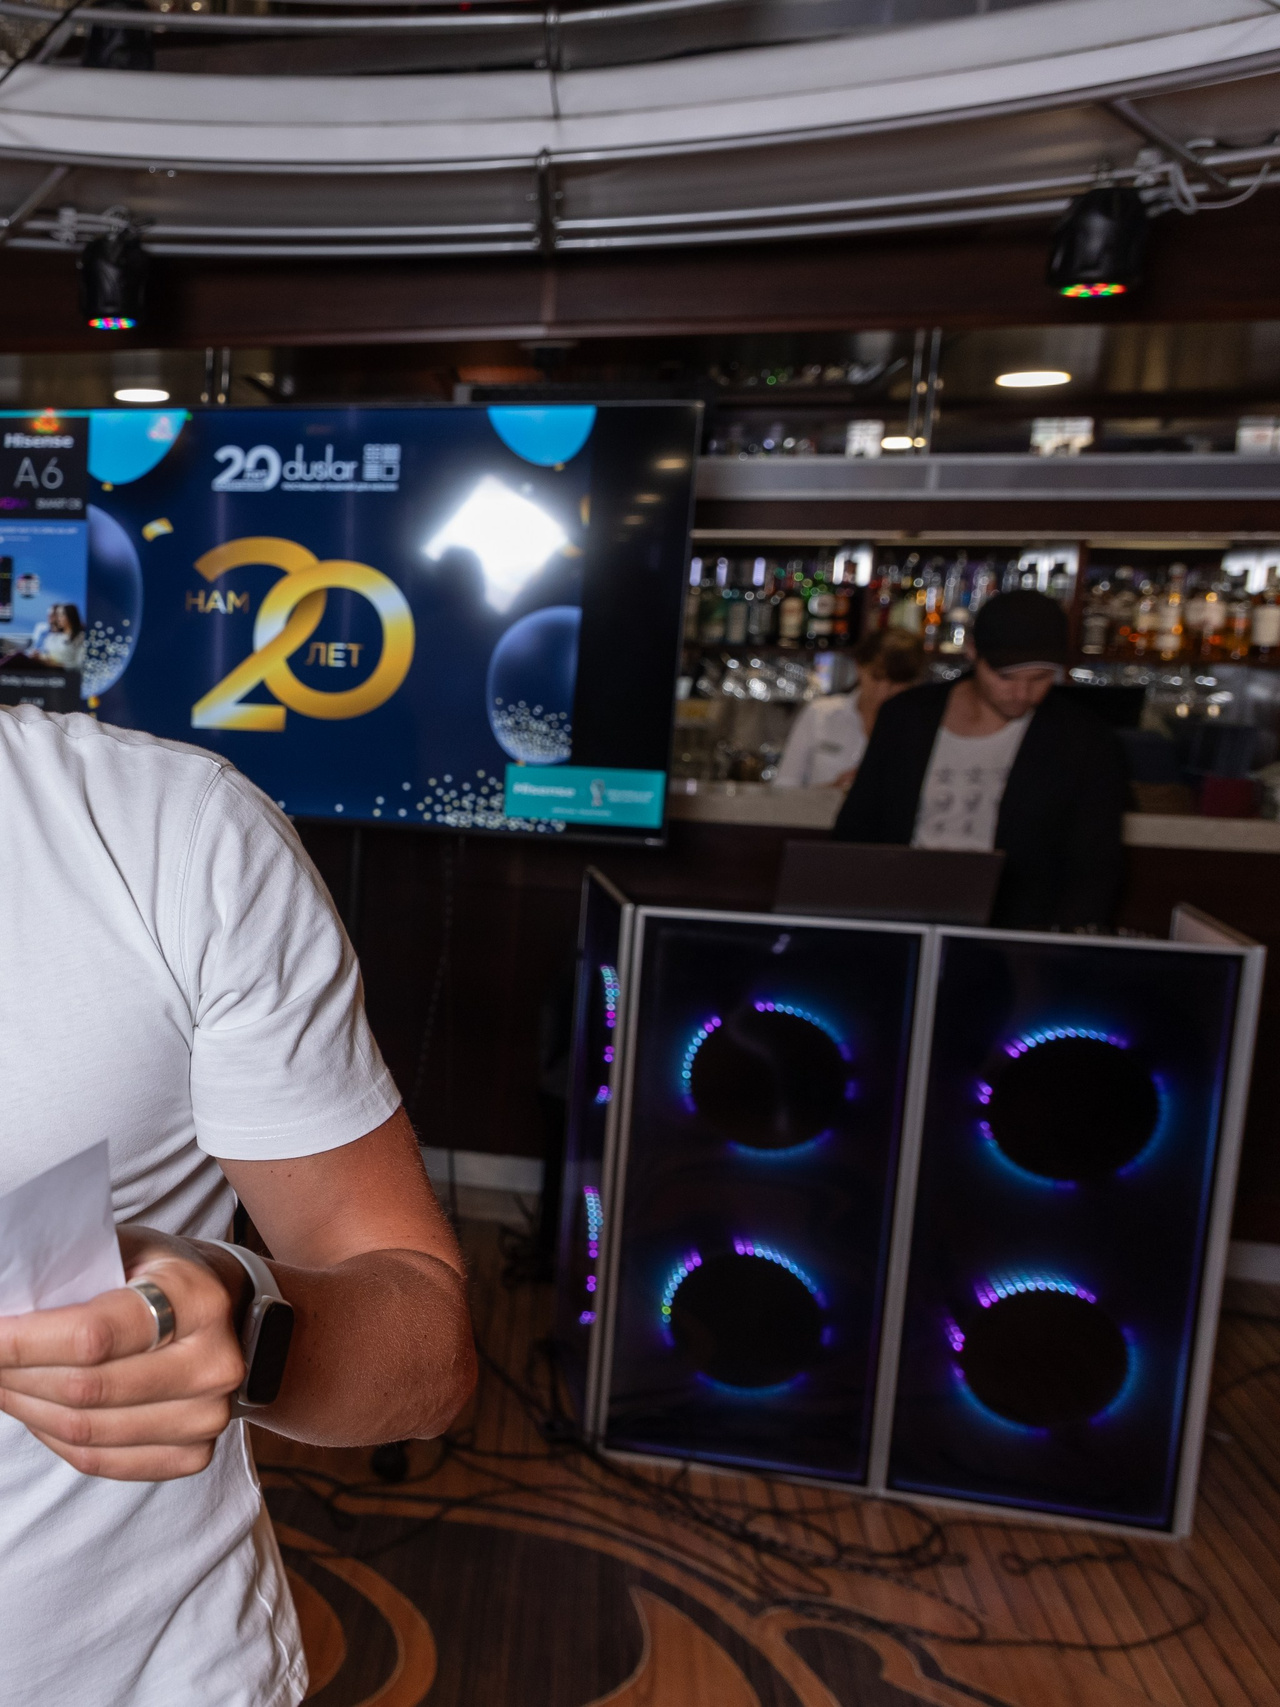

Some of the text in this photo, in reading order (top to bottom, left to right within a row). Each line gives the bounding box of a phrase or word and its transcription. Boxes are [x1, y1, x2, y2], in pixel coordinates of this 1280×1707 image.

[4, 433, 74, 448] Hisense
[13, 457, 64, 490] A6
[282, 444, 358, 481] duslar
[185, 536, 416, 733] НАМ 20 ЛЕТ
